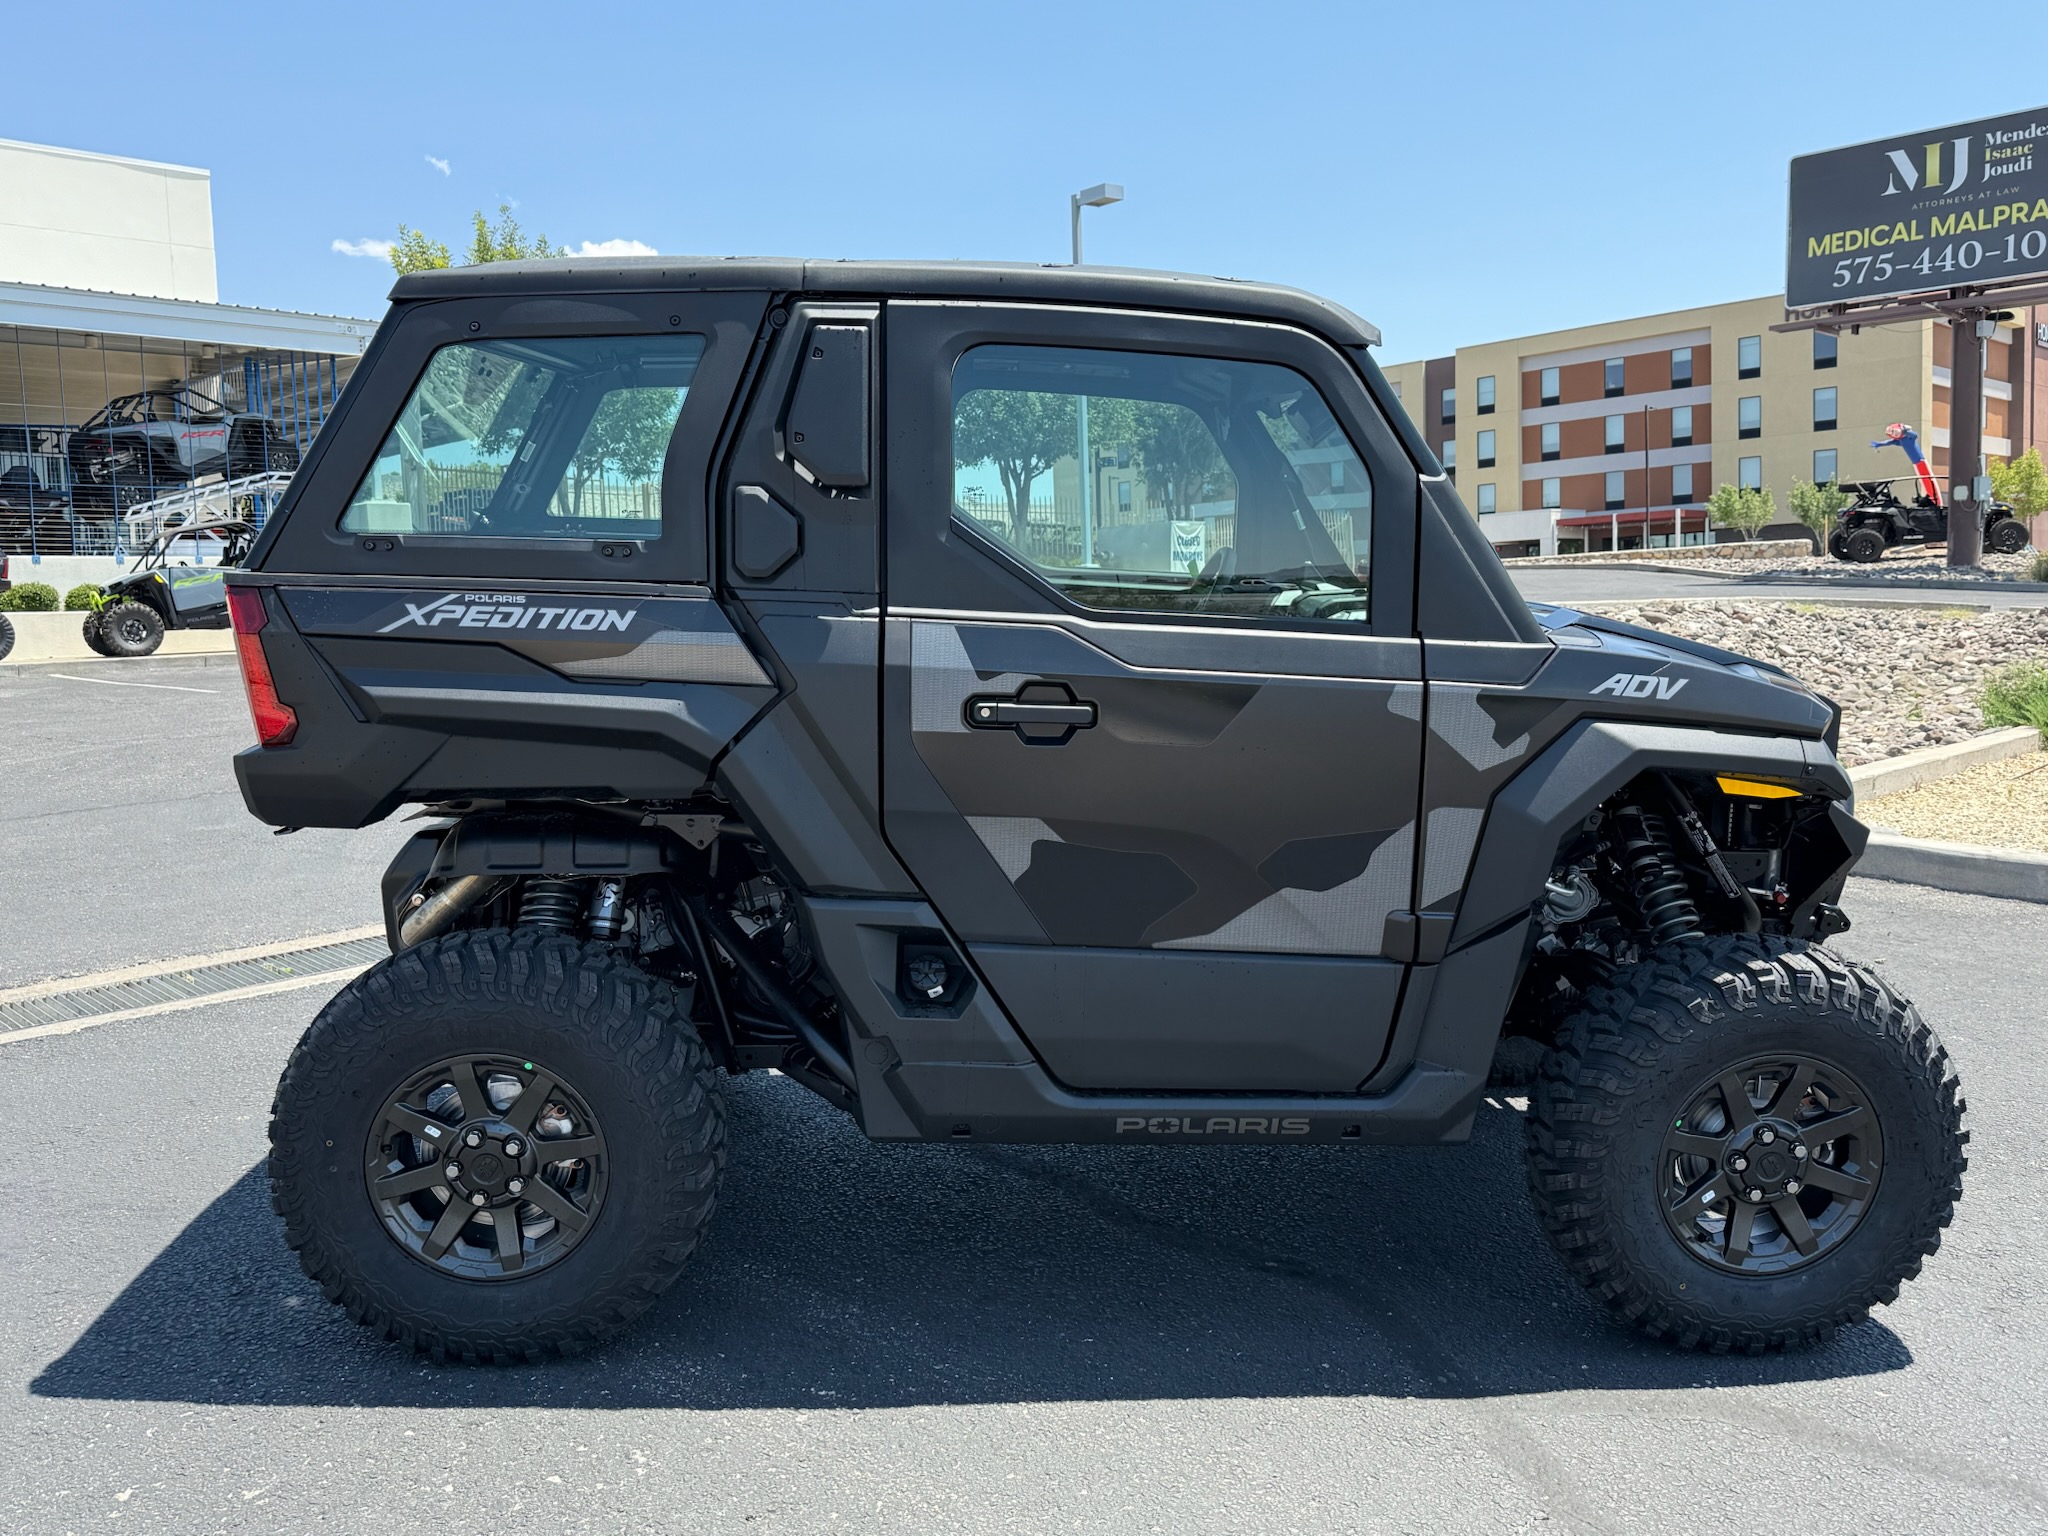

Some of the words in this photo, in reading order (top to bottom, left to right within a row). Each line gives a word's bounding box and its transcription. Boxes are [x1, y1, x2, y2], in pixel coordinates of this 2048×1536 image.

[1985, 123, 2048, 147] Mende
[1881, 136, 1973, 196] MIJ
[1985, 143, 2033, 162] Isaac
[1981, 156, 2033, 183] Joudi
[1912, 194, 1974, 210] ATTORNEYS
[1978, 191, 1991, 200] AT
[1996, 186, 2020, 196] LAW
[1808, 219, 1924, 258] MEDICAL
[1930, 198, 2048, 238] MALPRA
[1832, 230, 2047, 287] 575-440-10
[464, 594, 526, 604] POLARIS
[375, 593, 638, 633] XPEDITION
[1588, 673, 1690, 700] ADV
[1116, 1117, 1311, 1135] POLARIS
